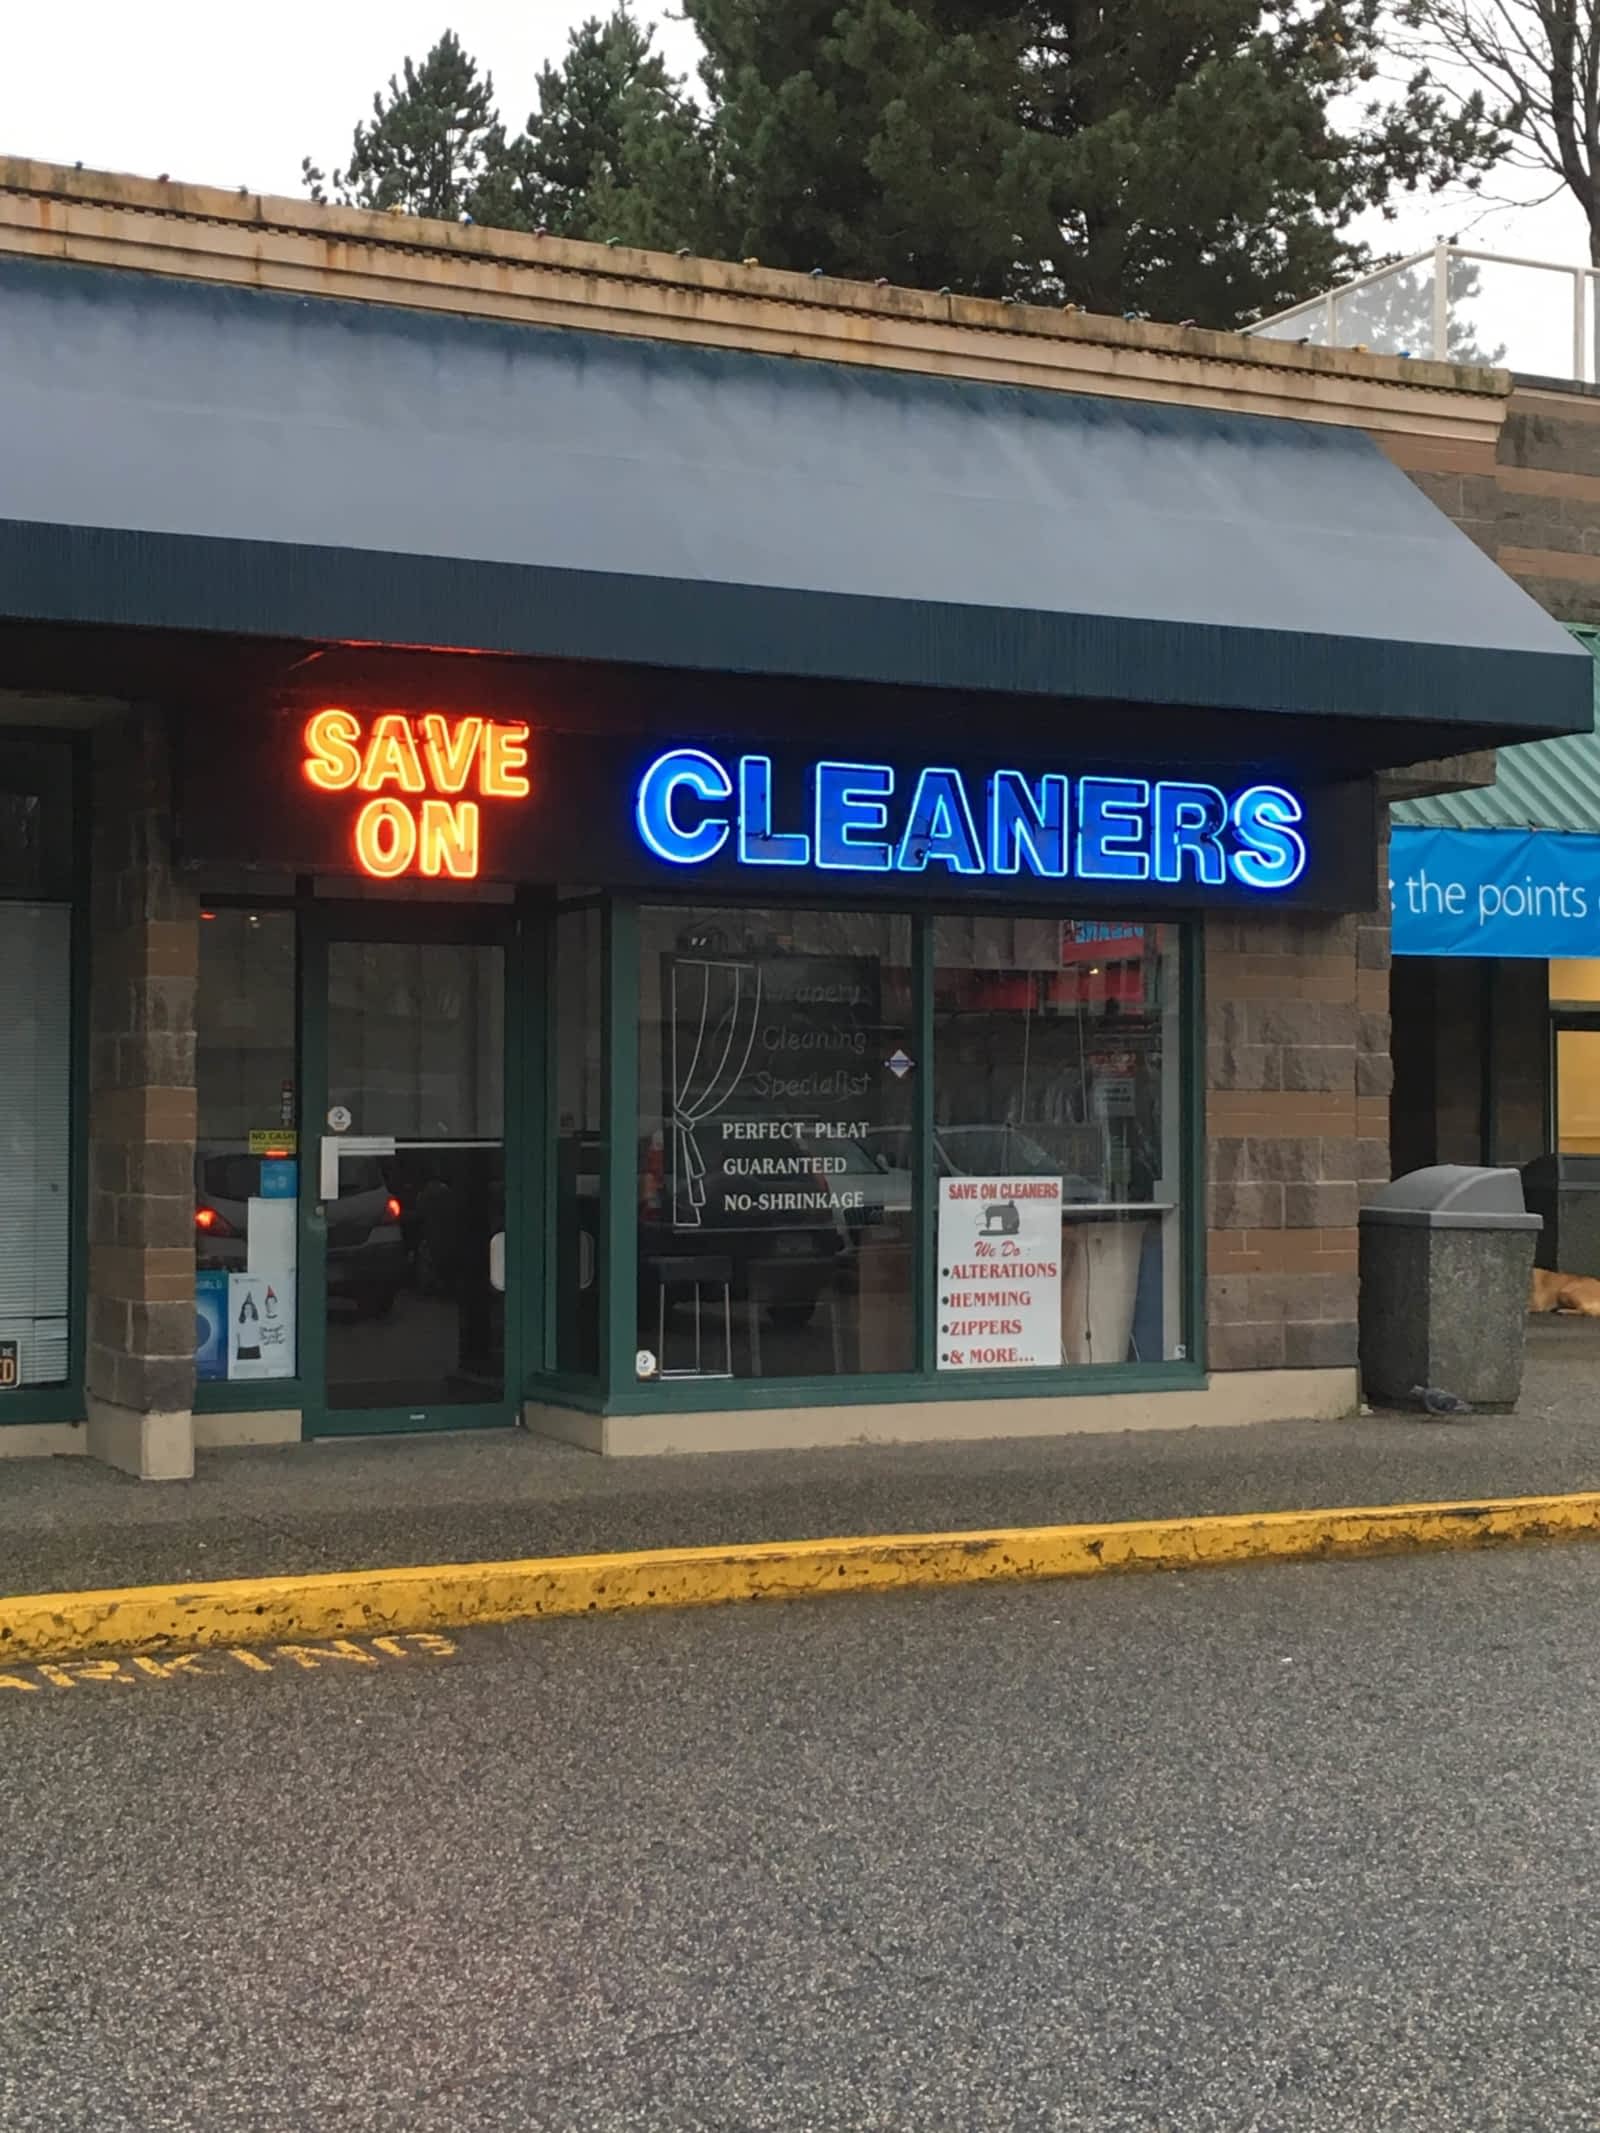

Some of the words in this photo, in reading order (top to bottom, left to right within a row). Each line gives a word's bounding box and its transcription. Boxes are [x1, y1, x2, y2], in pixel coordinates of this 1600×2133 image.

[304, 709, 530, 798] SAVE
[636, 749, 1306, 889] CLEANERS
[356, 797, 479, 878] ON
[1405, 868, 1466, 915] the
[1478, 875, 1588, 927] points
[763, 1024, 867, 1055] Cleaning
[752, 1069, 872, 1101] Specialist
[722, 1122, 804, 1140] PERFECT
[815, 1121, 869, 1139] PLEAT
[723, 1157, 847, 1176] GUARANTEED
[949, 1183, 978, 1200] SAVE
[980, 1183, 998, 1199] ON
[1001, 1182, 1059, 1199] CLEANERS
[724, 1192, 865, 1211] NO-SHRINKAGE
[974, 1240, 997, 1257] We
[1000, 1240, 1021, 1257] Do
[950, 1263, 1058, 1280] ALTERATIONS
[950, 1291, 1032, 1308] HEMMING
[950, 1319, 1023, 1336] ZIPPERS
[950, 1349, 965, 1365] &
[969, 1347, 1035, 1364] MORE...
